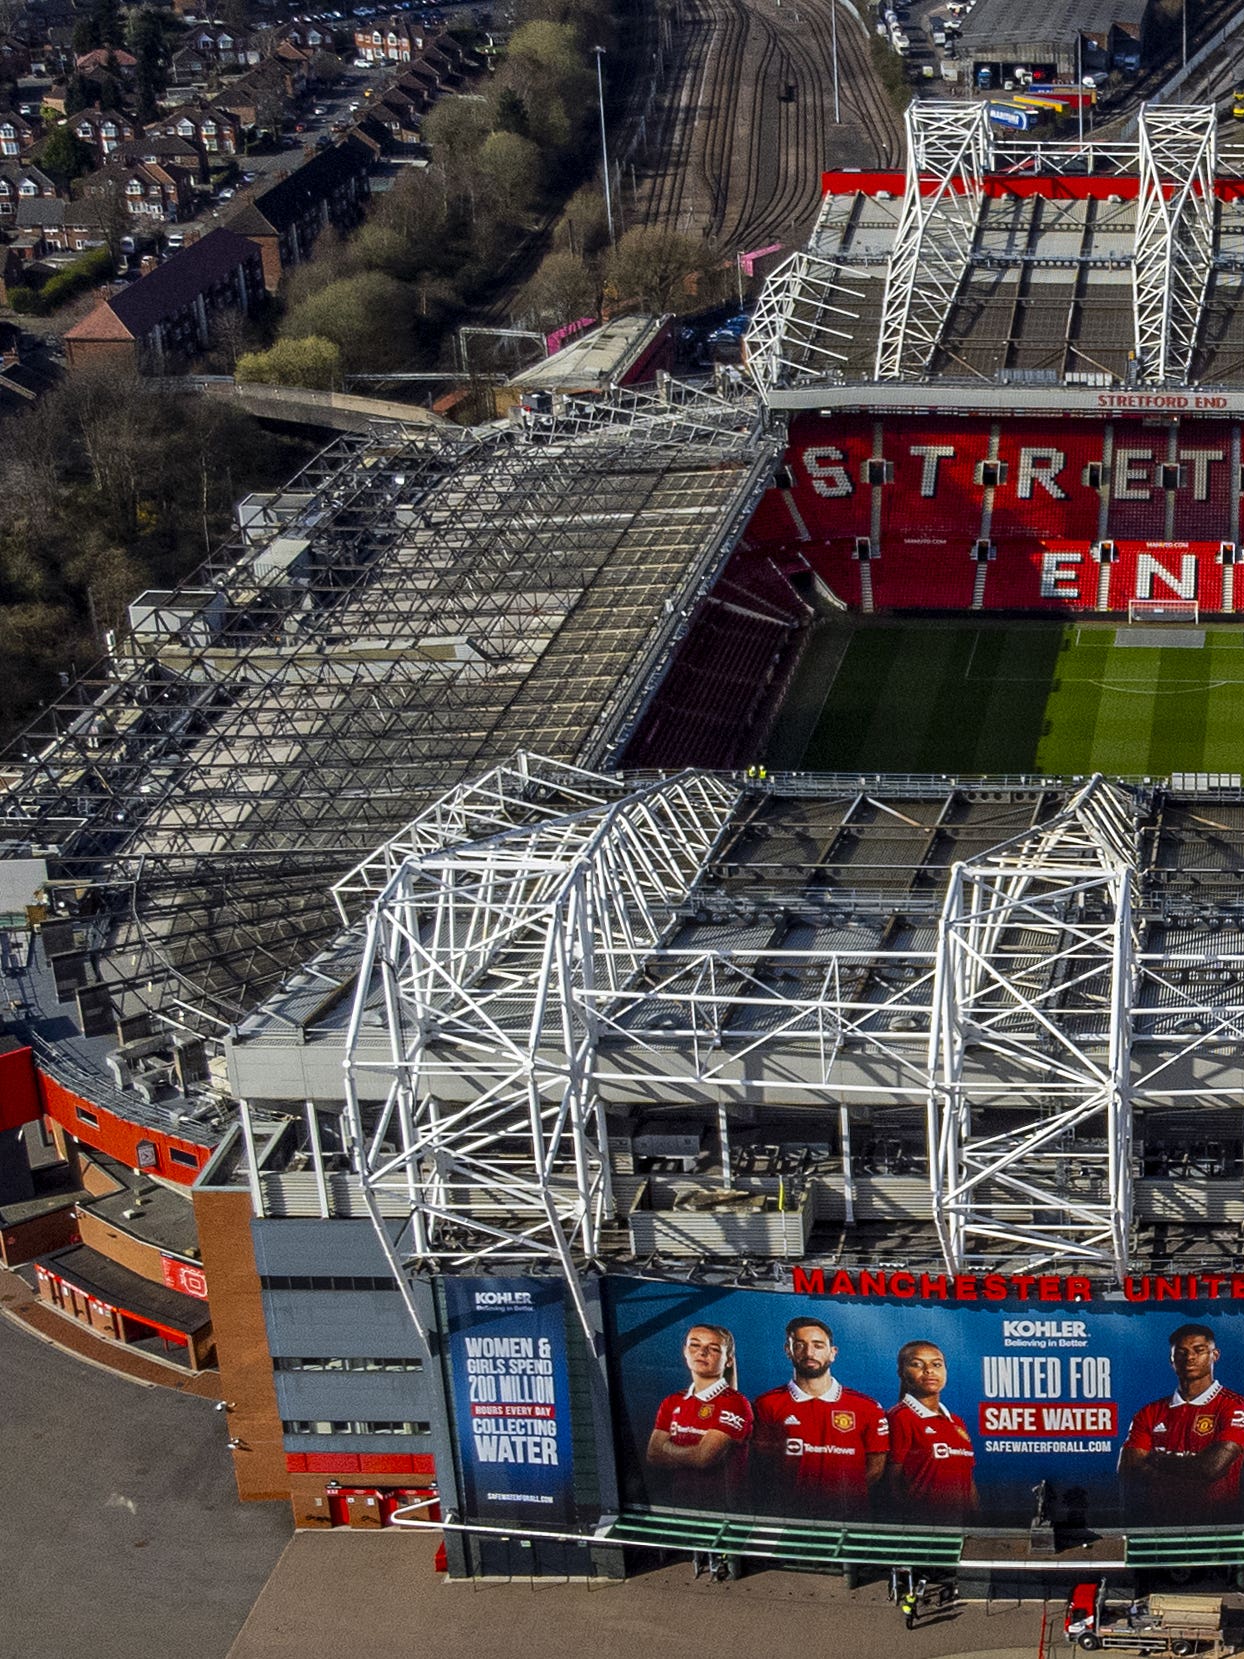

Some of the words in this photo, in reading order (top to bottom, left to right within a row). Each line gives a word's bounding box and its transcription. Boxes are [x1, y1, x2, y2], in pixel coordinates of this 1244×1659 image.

[1098, 395, 1189, 408] STRETFORD
[1195, 397, 1227, 409] END
[793, 1266, 1092, 1301] MANCHESTER
[465, 1337, 533, 1358] WOMEN
[538, 1338, 551, 1358] &
[1004, 1339, 1047, 1348] Believing
[1048, 1339, 1057, 1347] in
[467, 1359, 506, 1374] GIRLS
[509, 1359, 553, 1375] SPEND
[983, 1356, 1062, 1399] UNITED
[1070, 1356, 1111, 1399] FOR
[469, 1375, 497, 1402] 200
[499, 1375, 555, 1404] MILLION
[475, 1406, 503, 1415] HOURS
[505, 1406, 532, 1415] EVERY
[535, 1407, 551, 1416] DAY
[985, 1407, 1037, 1431] SAFE
[1041, 1407, 1112, 1431] WATER
[472, 1418, 557, 1437] COLLECTING
[474, 1434, 559, 1465] WATER
[985, 1440, 1111, 1453] SAFEWATERFORALL.COM
